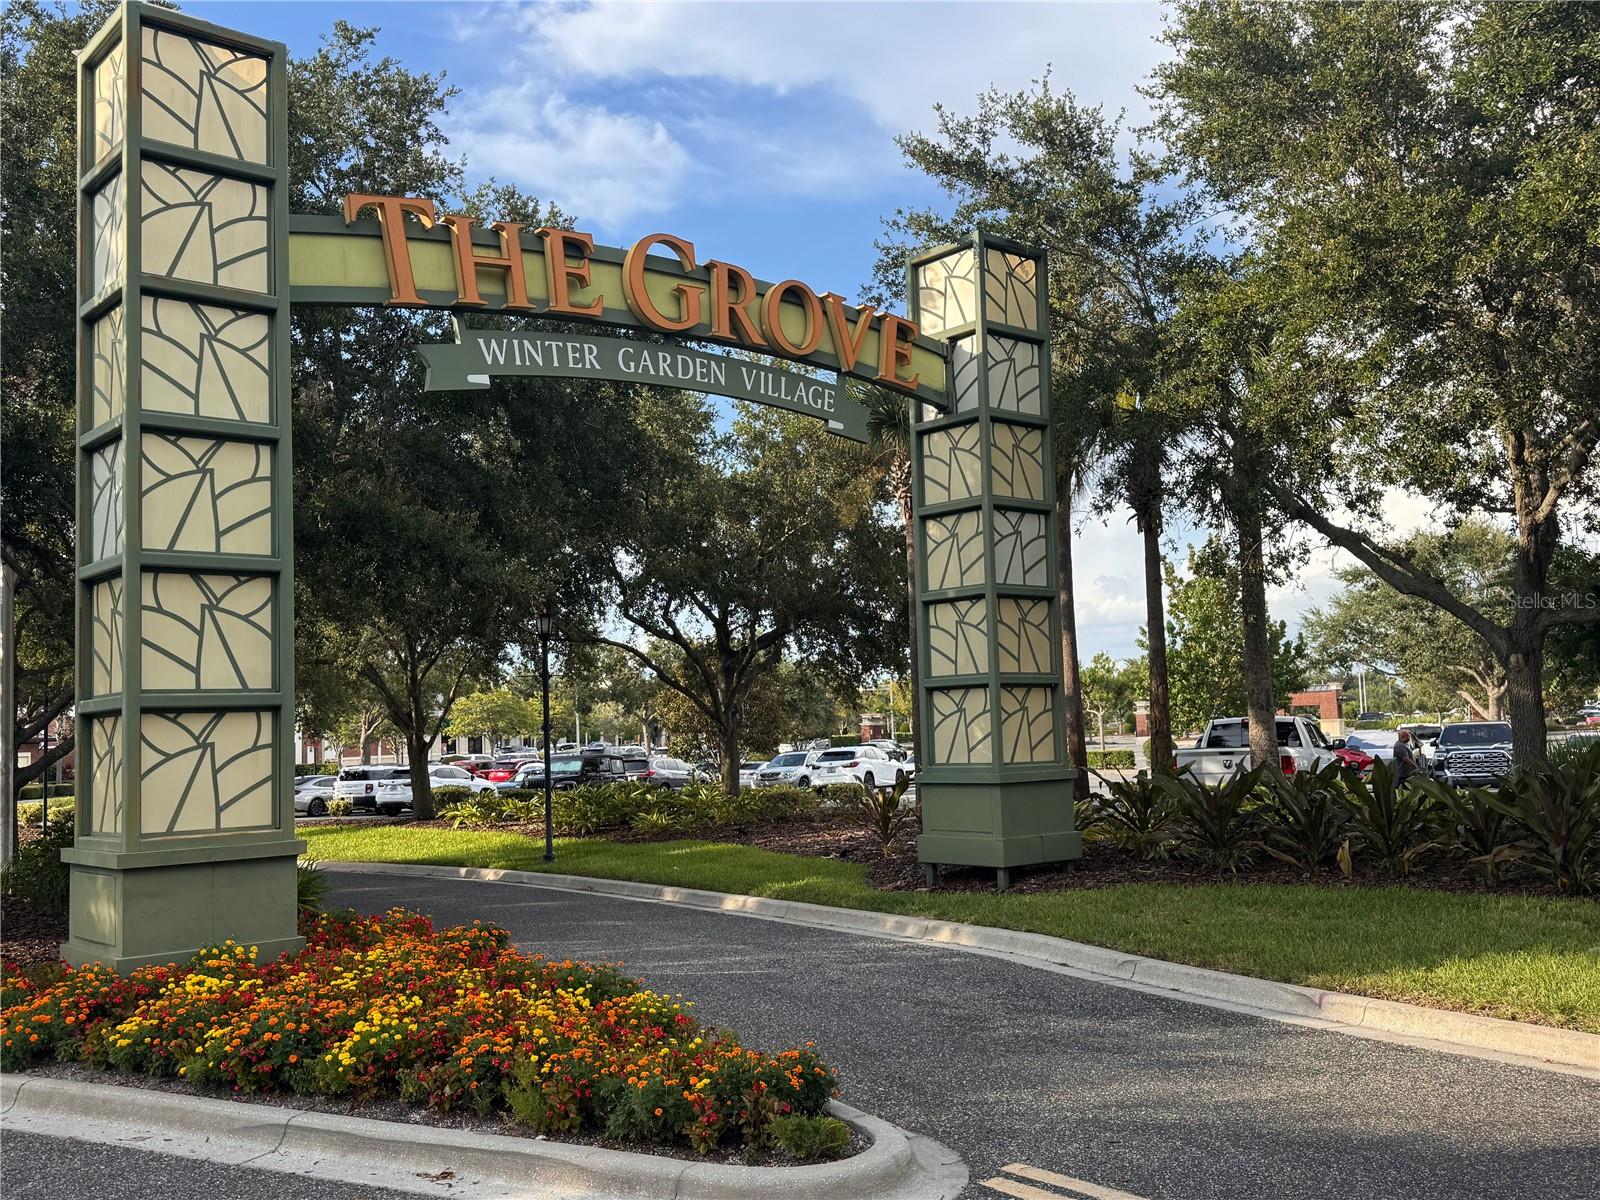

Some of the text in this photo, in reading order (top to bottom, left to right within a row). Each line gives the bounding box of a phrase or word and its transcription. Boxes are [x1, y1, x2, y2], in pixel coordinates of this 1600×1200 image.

[477, 338, 836, 413] WINTER GARDEN VILLAGE
